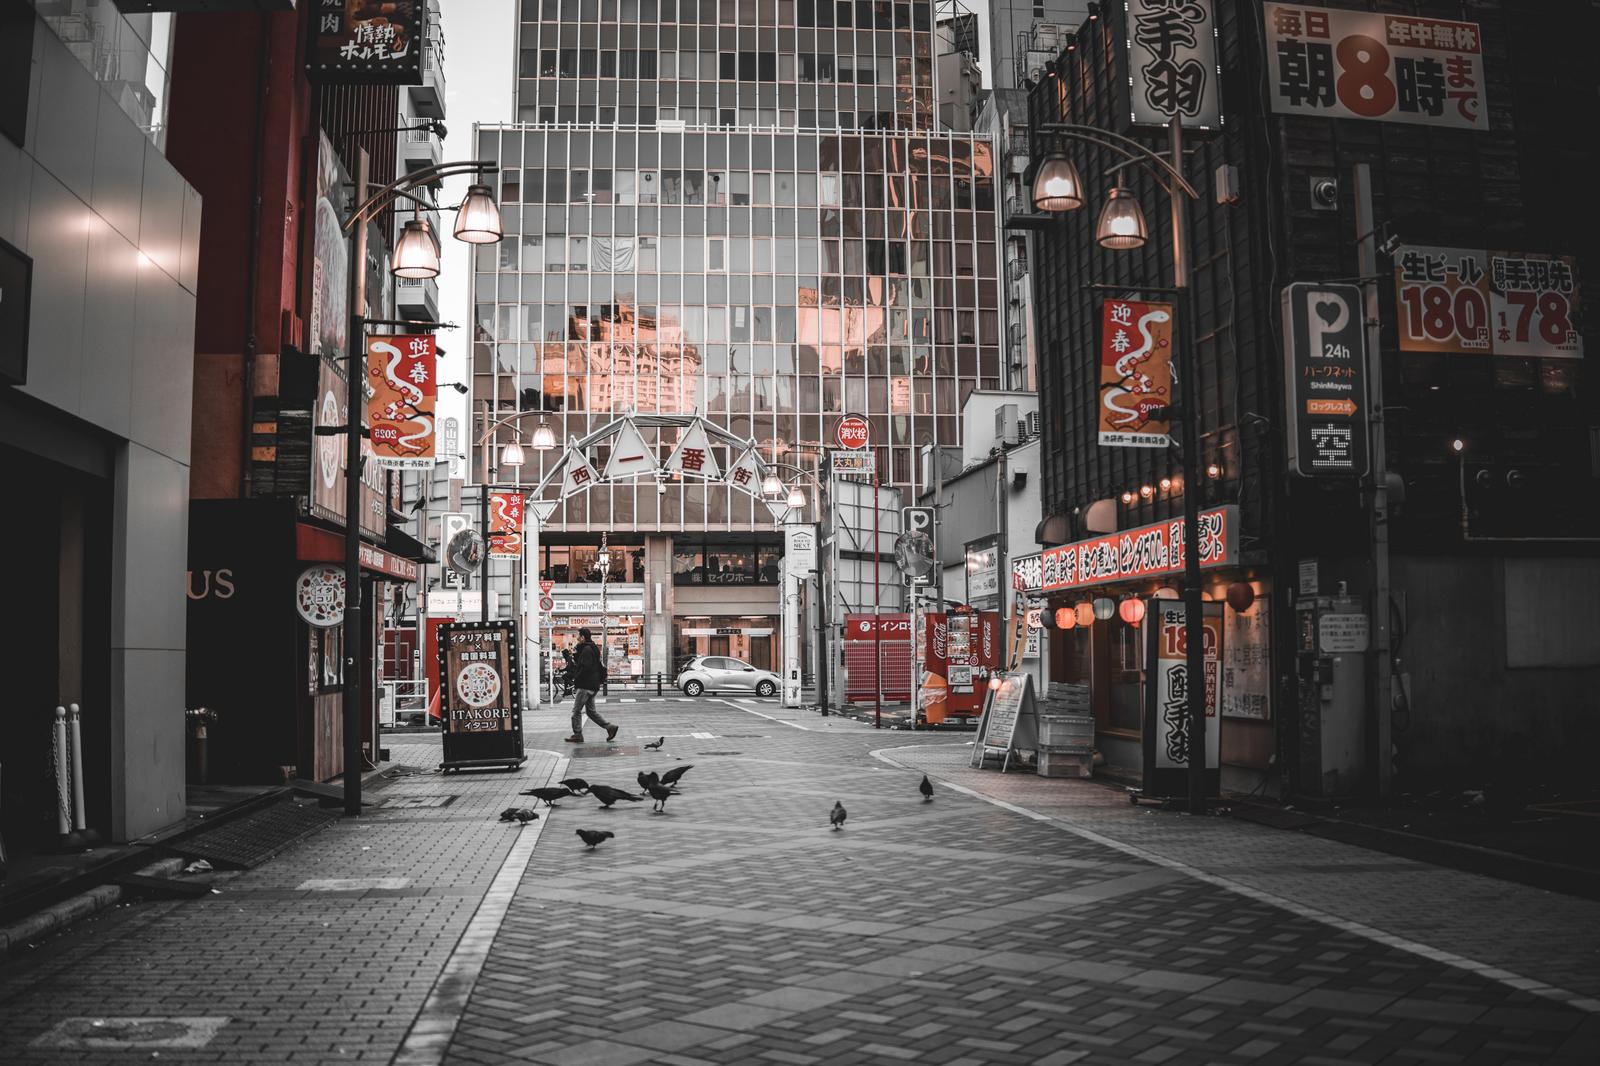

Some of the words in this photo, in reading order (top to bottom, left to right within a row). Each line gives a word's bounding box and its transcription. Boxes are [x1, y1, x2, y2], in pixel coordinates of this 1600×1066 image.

[1273, 7, 1330, 38] 毎日
[354, 23, 396, 44] 情熱
[1389, 20, 1476, 50] 年中無休
[340, 40, 410, 60] ホルモン
[1401, 252, 1485, 286] 生ビール
[1110, 304, 1132, 353] 迎春
[1307, 292, 1349, 357] P
[1325, 344, 1351, 358] 24h
[1311, 381, 1353, 391] ShinMaywa
[841, 427, 867, 440] 消火栓
[1104, 434, 1165, 445] 池袋西一番街商店会
[1311, 424, 1352, 466] 空
[450, 632, 502, 643] イタリア料理
[461, 651, 497, 661] 韓国料理
[451, 708, 510, 720] ITAKORE
[464, 721, 497, 729] イタコリ
